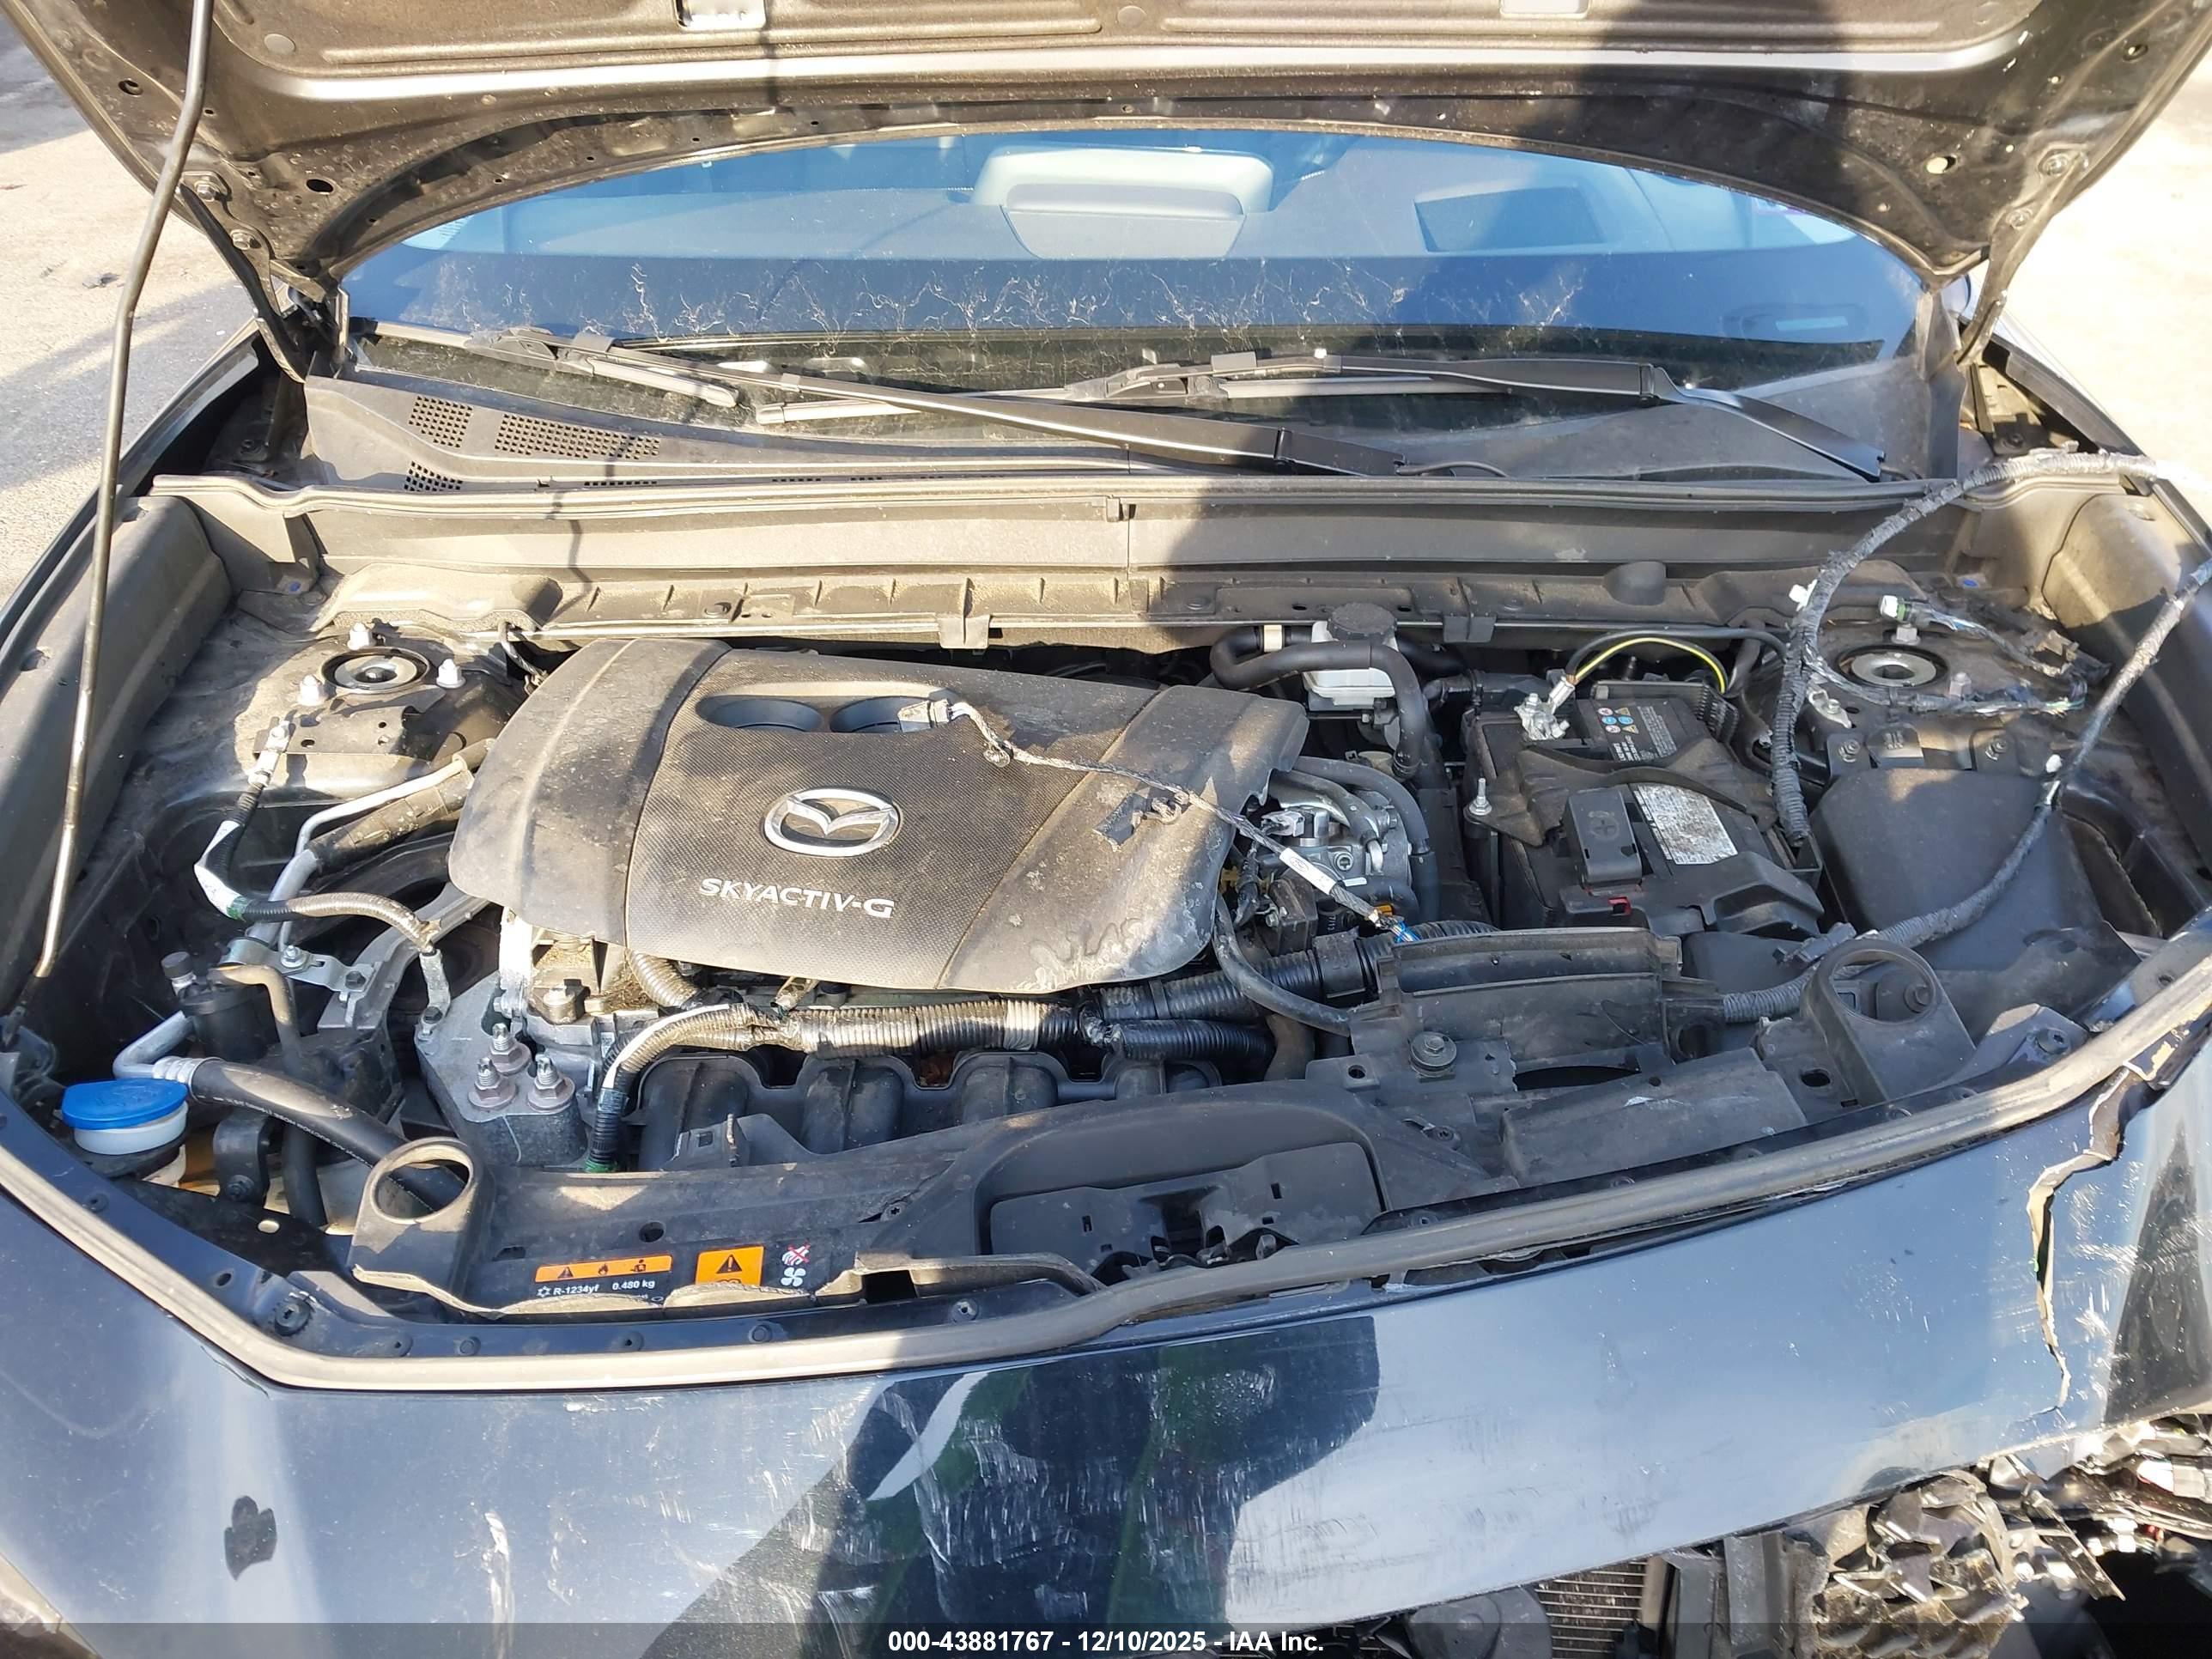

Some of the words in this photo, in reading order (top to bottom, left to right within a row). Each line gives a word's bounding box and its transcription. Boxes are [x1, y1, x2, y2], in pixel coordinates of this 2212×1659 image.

[699, 878, 895, 918] SKYACTIV-G
[552, 1284, 599, 1296] R-1234yf
[641, 1279, 656, 1289] kg
